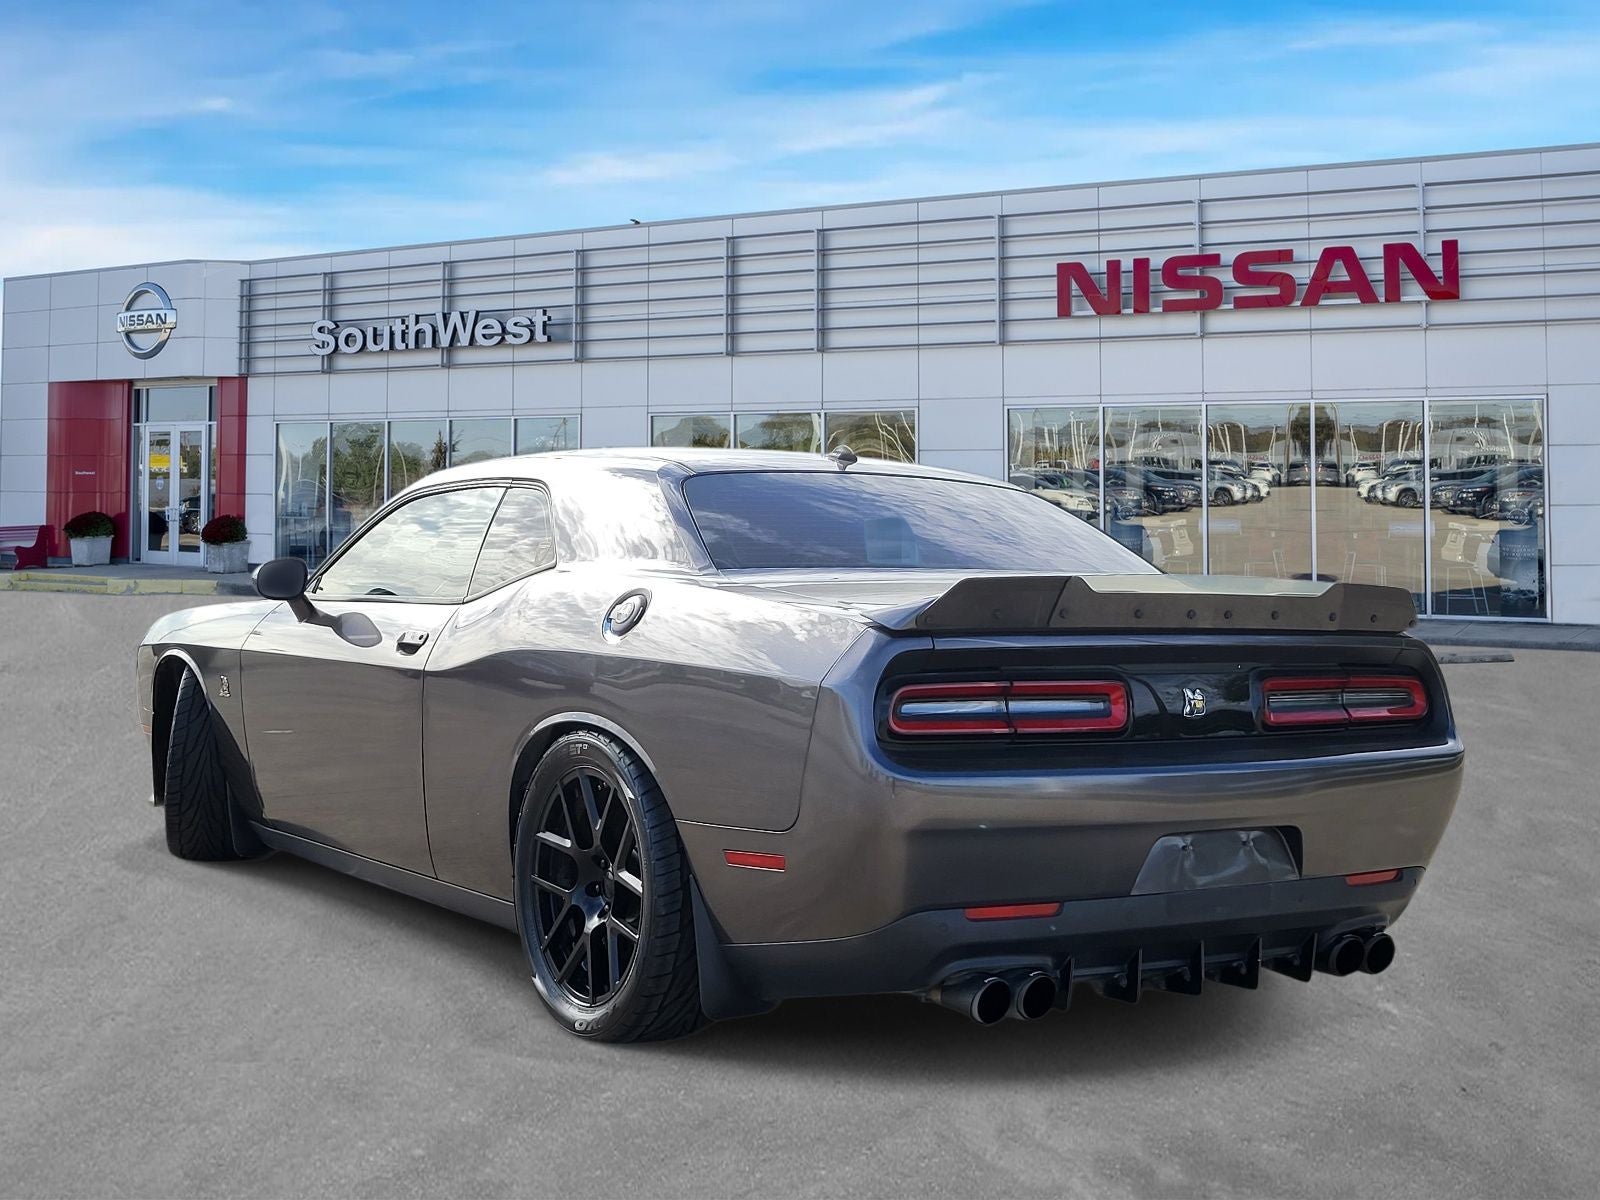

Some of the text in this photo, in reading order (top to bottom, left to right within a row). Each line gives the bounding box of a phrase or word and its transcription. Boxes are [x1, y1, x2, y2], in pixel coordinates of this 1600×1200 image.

[1057, 239, 1460, 318] NISSAN
[119, 313, 167, 327] NISSAN
[310, 309, 550, 355] SouthWest
